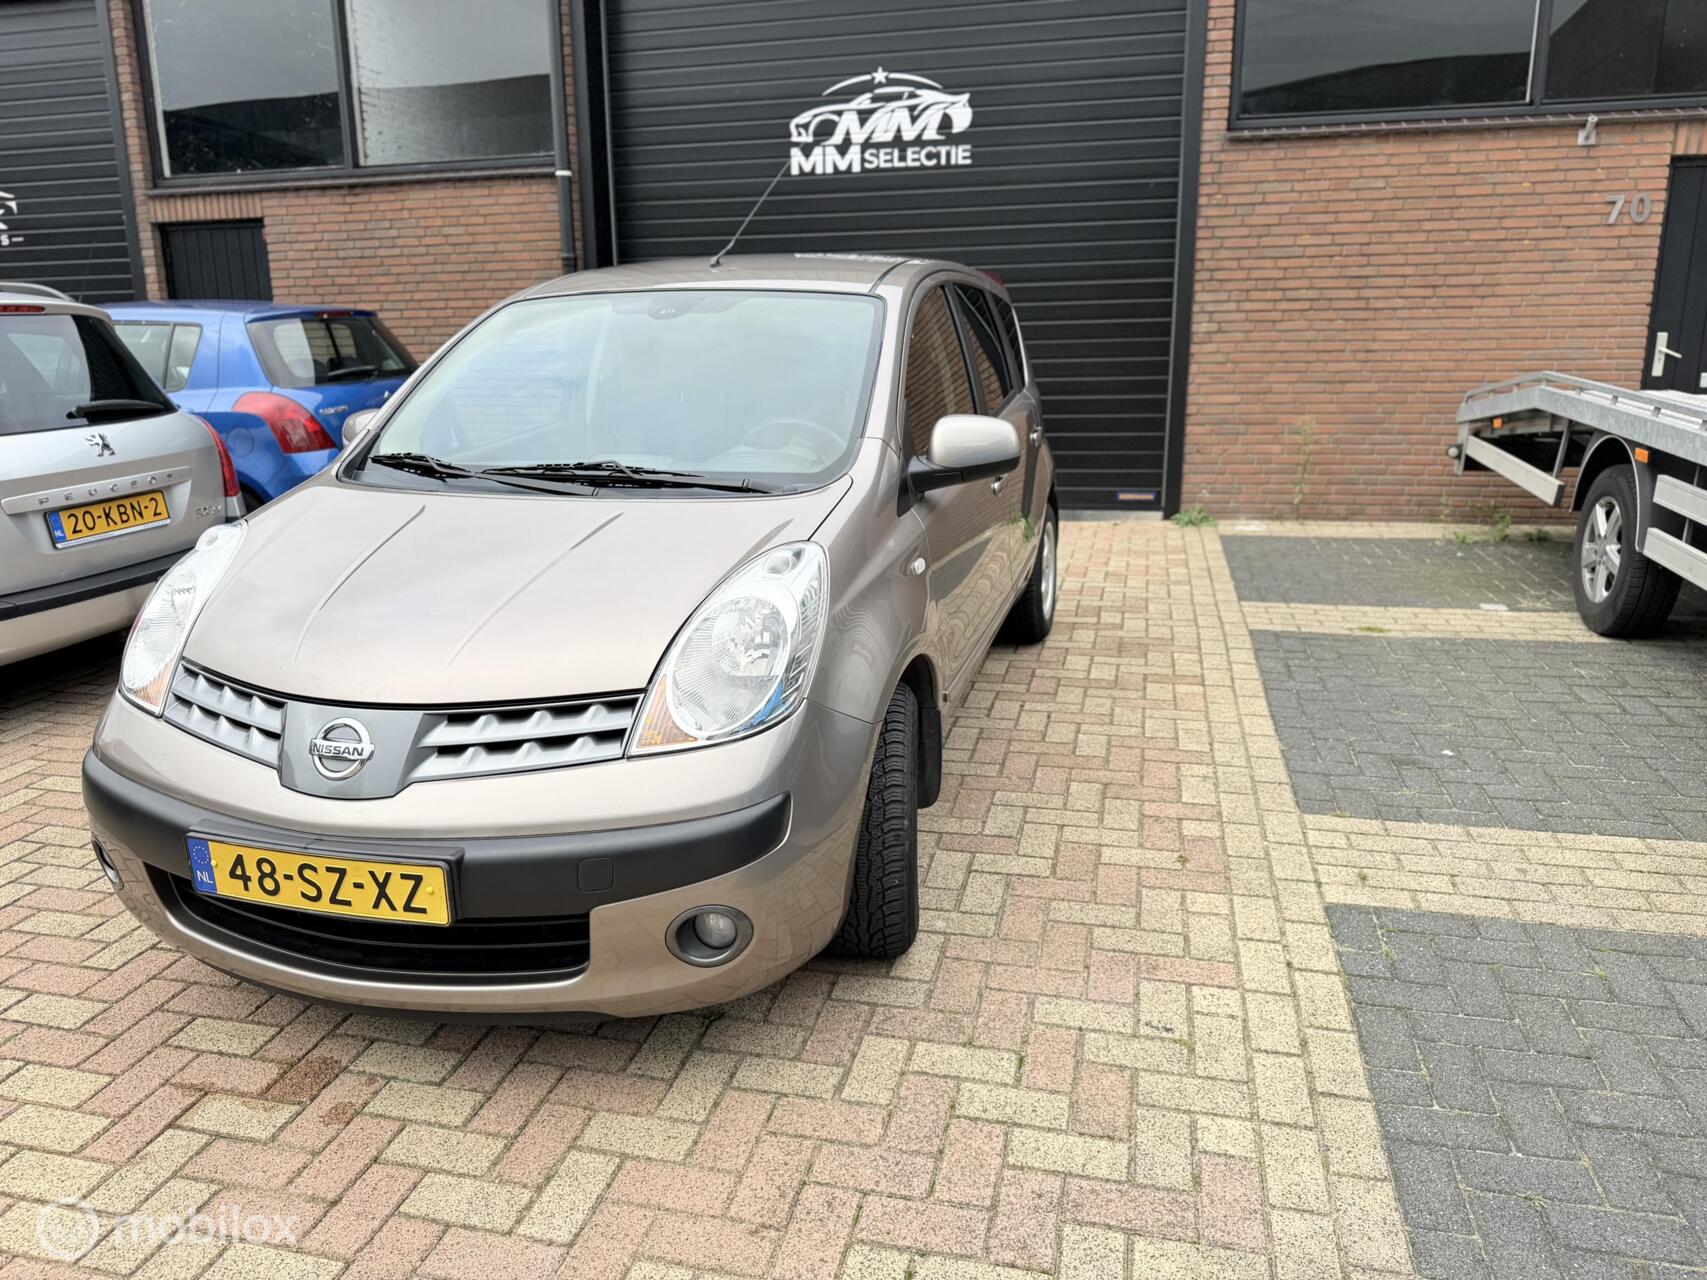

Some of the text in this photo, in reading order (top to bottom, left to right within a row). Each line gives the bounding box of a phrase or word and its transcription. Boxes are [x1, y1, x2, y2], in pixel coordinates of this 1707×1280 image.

[789, 144, 972, 176] MM SELECTIE
[1606, 191, 1652, 225] 70
[54, 530, 65, 538] NL
[67, 497, 162, 535] 20-KBN-2
[312, 742, 365, 757] NISSAN
[196, 853, 428, 915] NL 48-SZ-XZ
